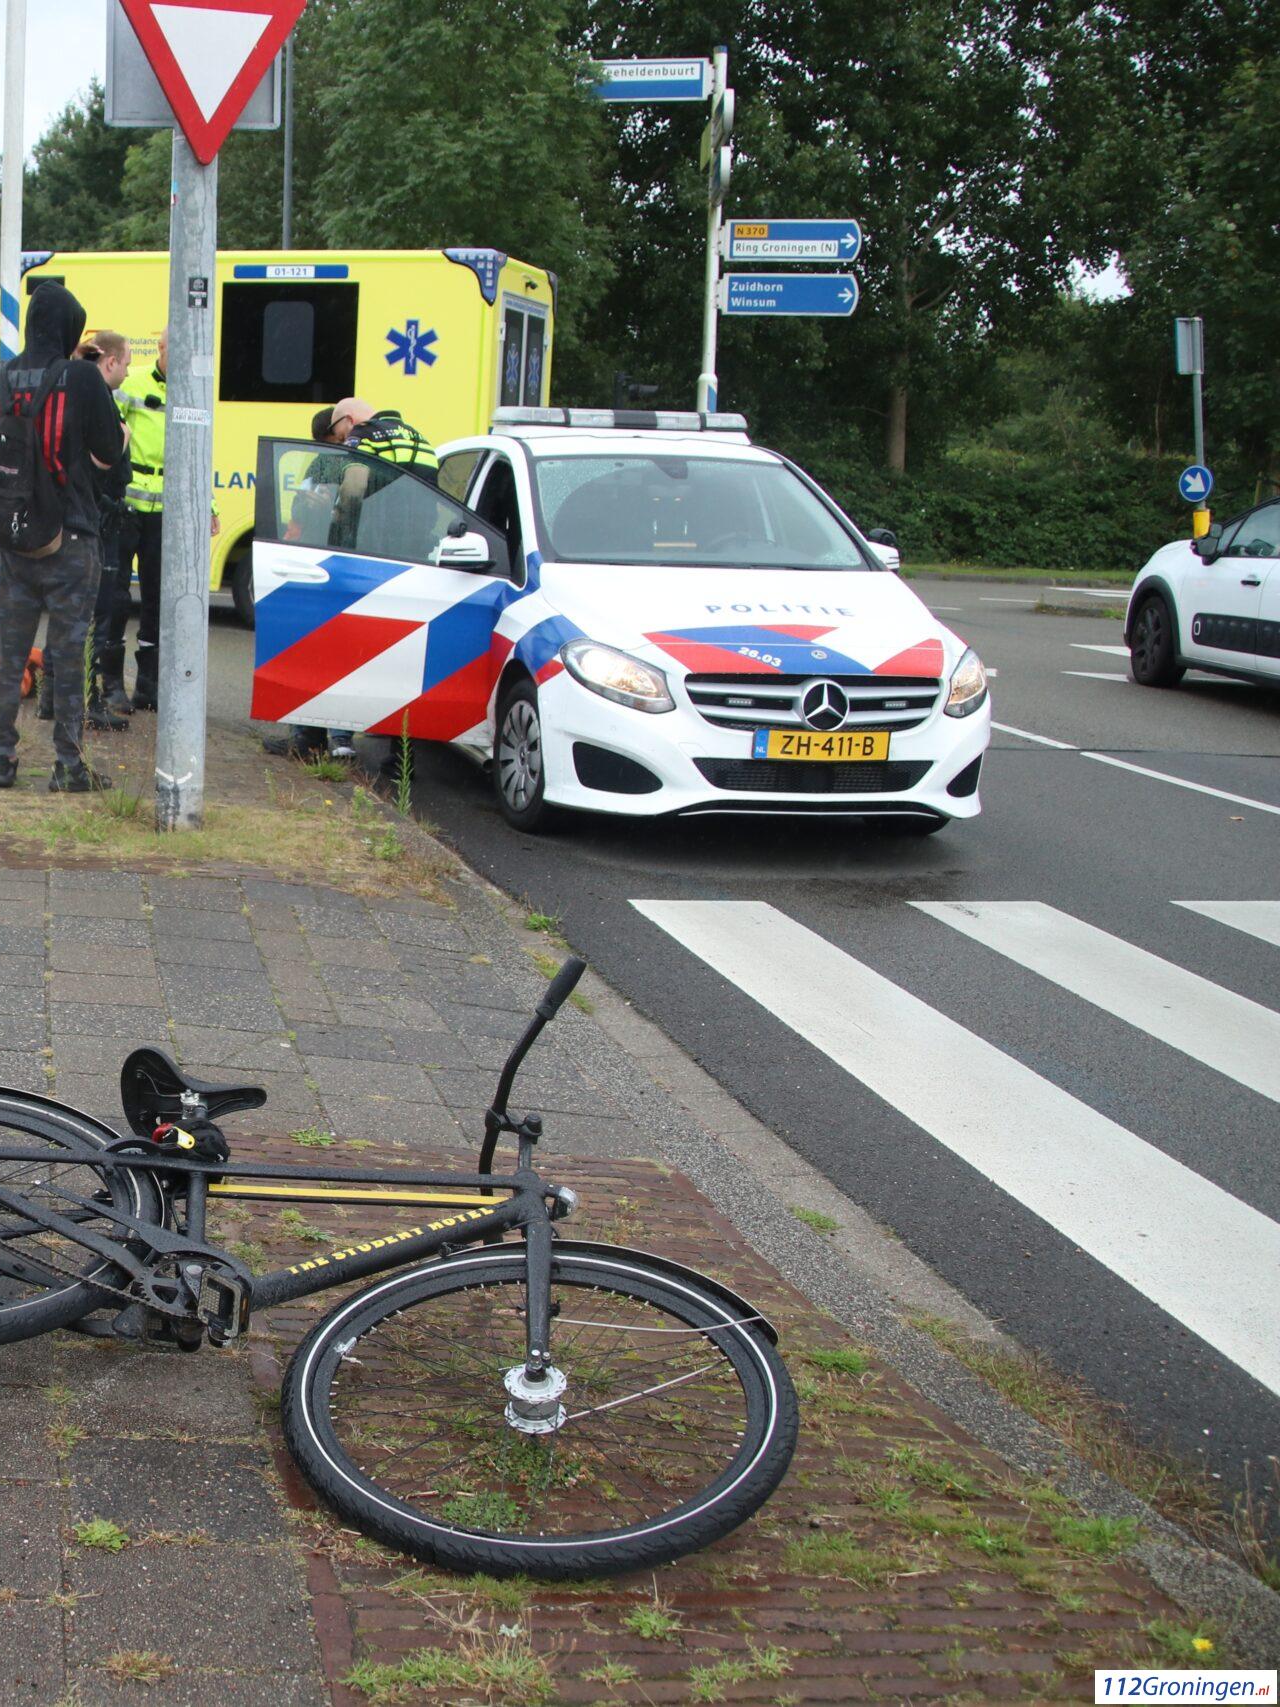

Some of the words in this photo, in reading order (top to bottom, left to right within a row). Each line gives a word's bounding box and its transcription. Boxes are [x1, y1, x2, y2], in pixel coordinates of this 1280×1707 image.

[735, 243, 758, 254] Ring
[762, 243, 817, 254] Groningen
[821, 243, 837, 253] (N)
[274, 267, 307, 276] 01-121
[731, 282, 784, 292] Zuidhorn
[731, 297, 776, 307] Winsum
[705, 604, 855, 617] POLITIE
[737, 646, 782, 667] 26.03
[756, 746, 766, 754] NL
[780, 735, 875, 756] ZH-411-B
[286, 1256, 330, 1275] THE
[332, 1227, 424, 1260] STUDENT
[427, 1206, 495, 1232] HOTEL
